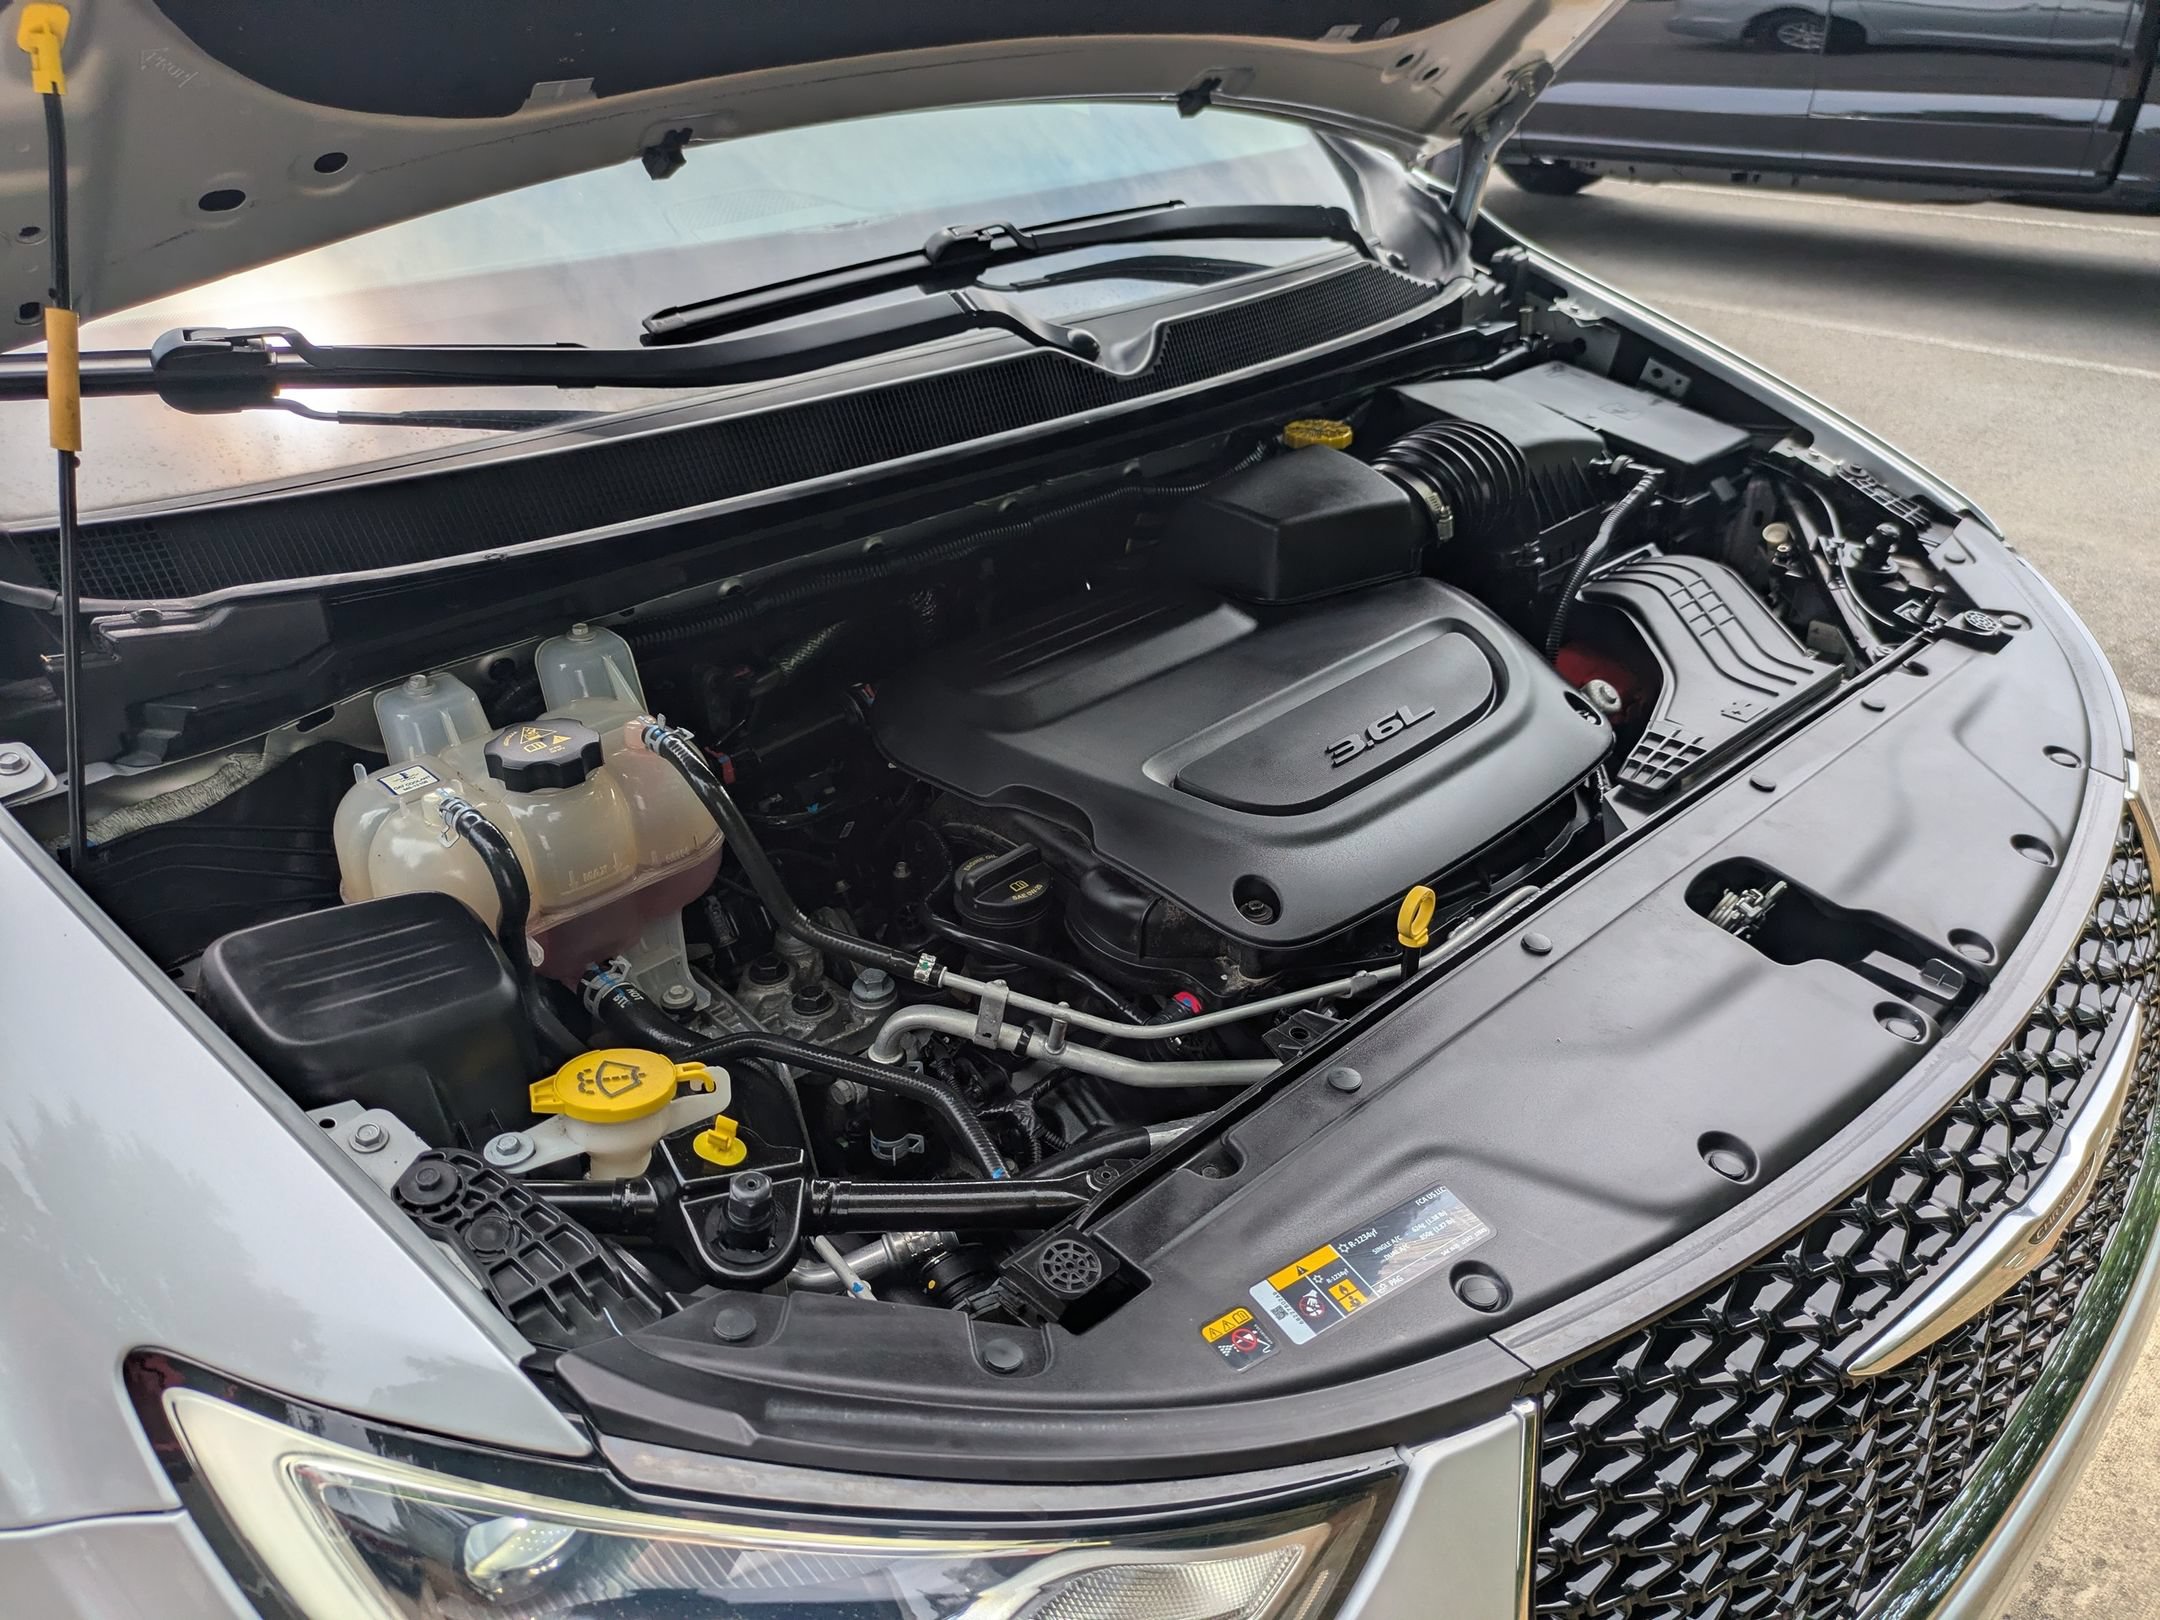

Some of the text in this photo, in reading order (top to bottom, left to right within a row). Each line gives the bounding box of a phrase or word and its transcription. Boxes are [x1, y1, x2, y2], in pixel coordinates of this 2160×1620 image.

[1325, 705, 1436, 768] 3.6L
[963, 856, 985, 872] ENGINE
[1415, 1185, 1447, 1206] FCA US LLC
[2036, 1165, 2091, 1239] CHRYSLER
[1348, 1228, 1378, 1249] R-1234yf
[1371, 1239, 1394, 1255] SINGLE
[1391, 1235, 1403, 1245] A/C
[1383, 1247, 1402, 1261] DUAL
[1388, 1275, 1405, 1287] PAG
